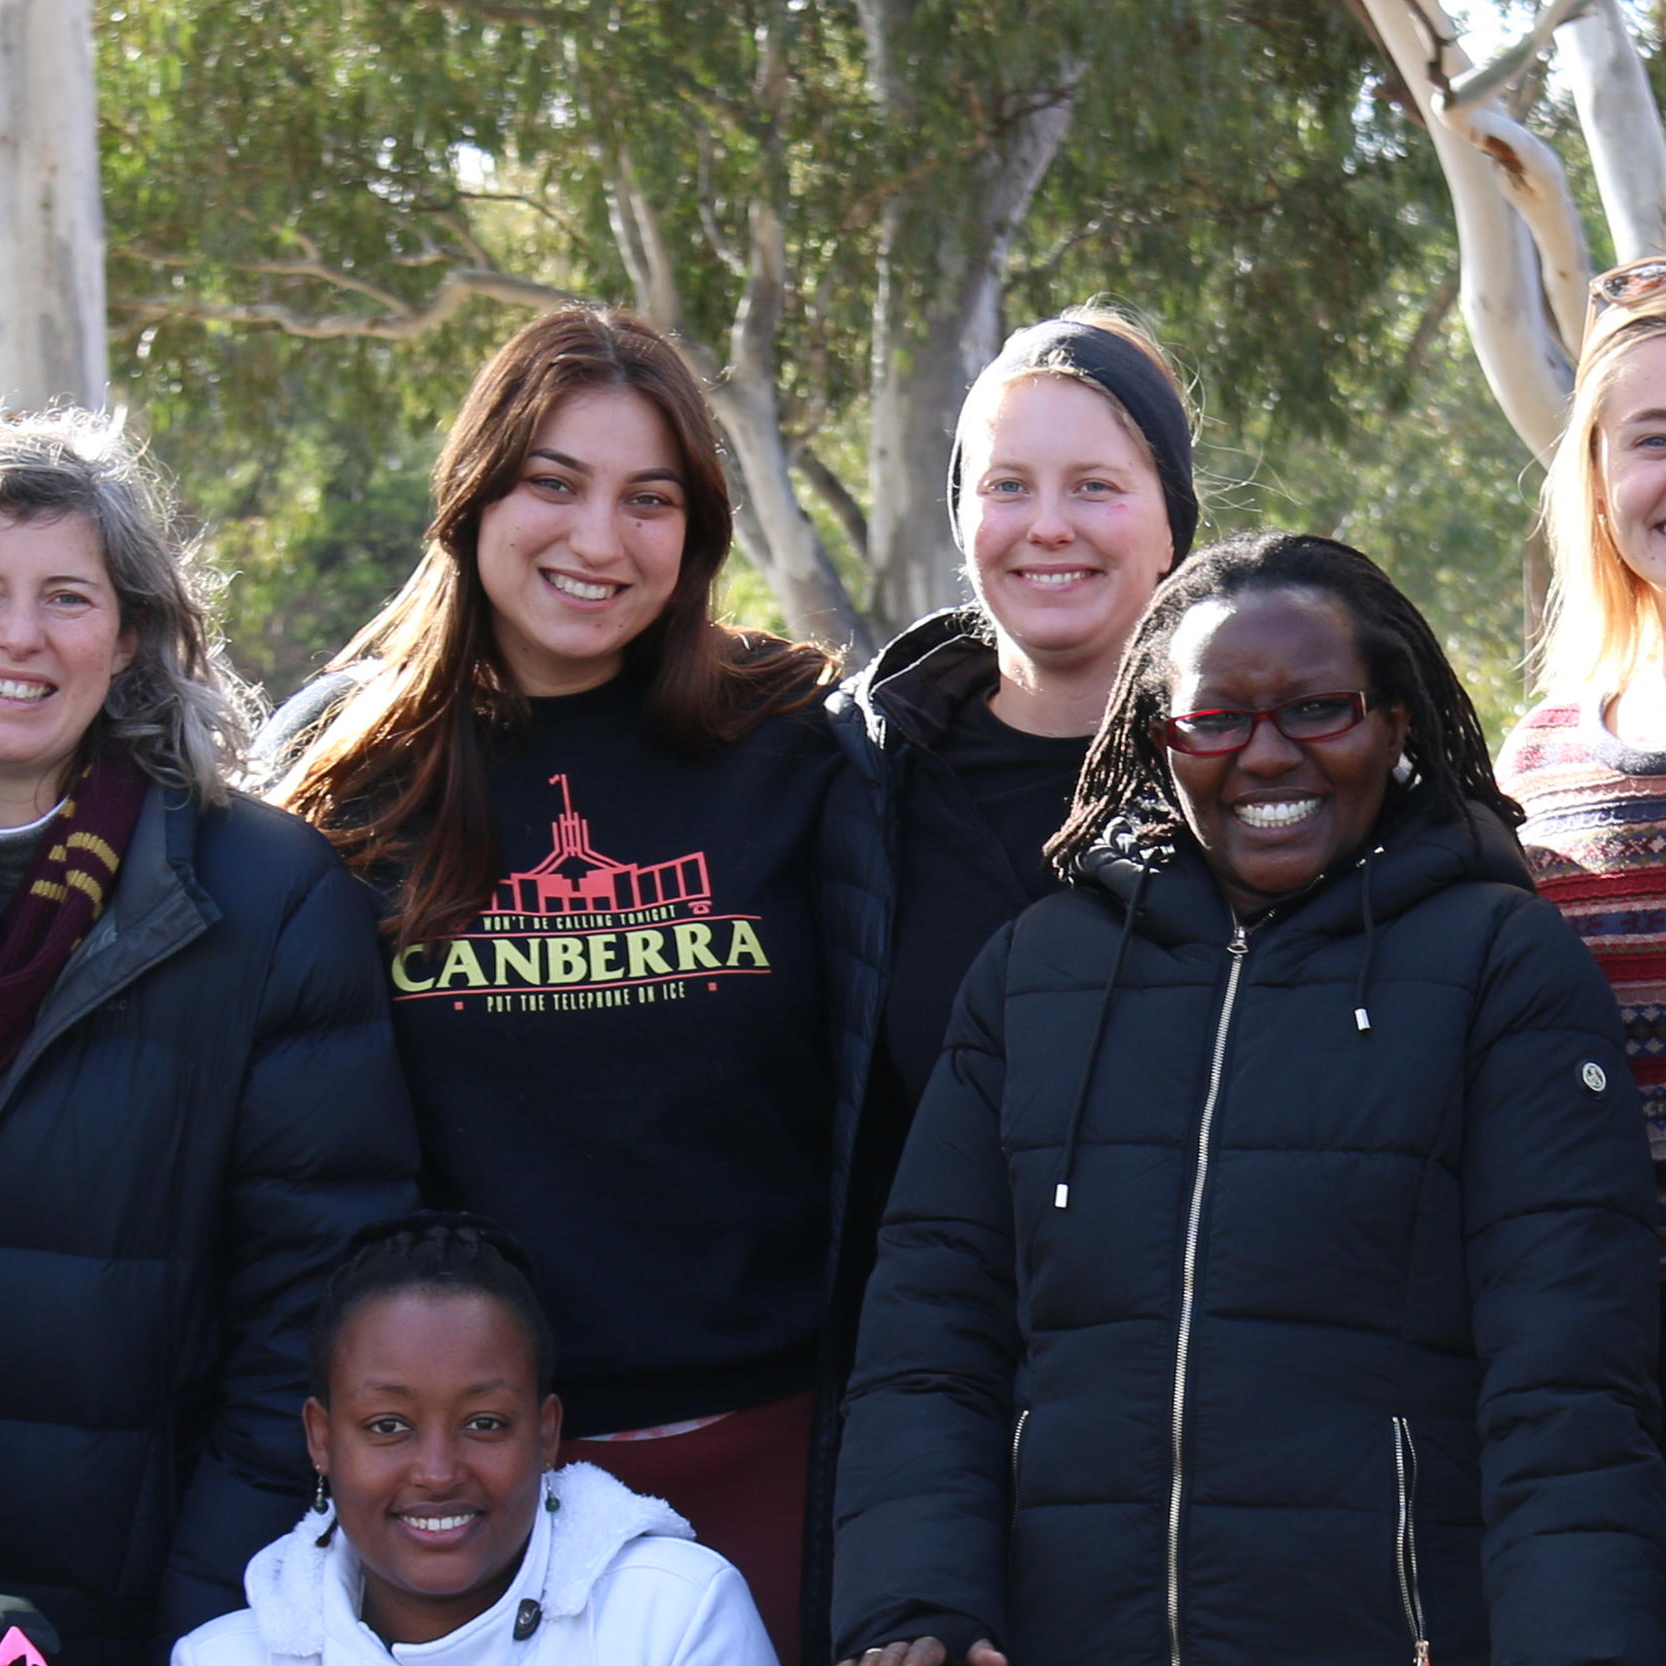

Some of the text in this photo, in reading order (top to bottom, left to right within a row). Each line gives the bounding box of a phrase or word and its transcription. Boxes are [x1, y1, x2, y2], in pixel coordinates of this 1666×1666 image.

[483, 904, 676, 932] WON'T BE CALLING TONIGHT
[391, 920, 770, 992] CANBERRA
[487, 995, 514, 1013] PUT
[521, 994, 545, 1012] THE
[553, 985, 631, 1011] TELEPHONE
[663, 981, 685, 1000] ICE
